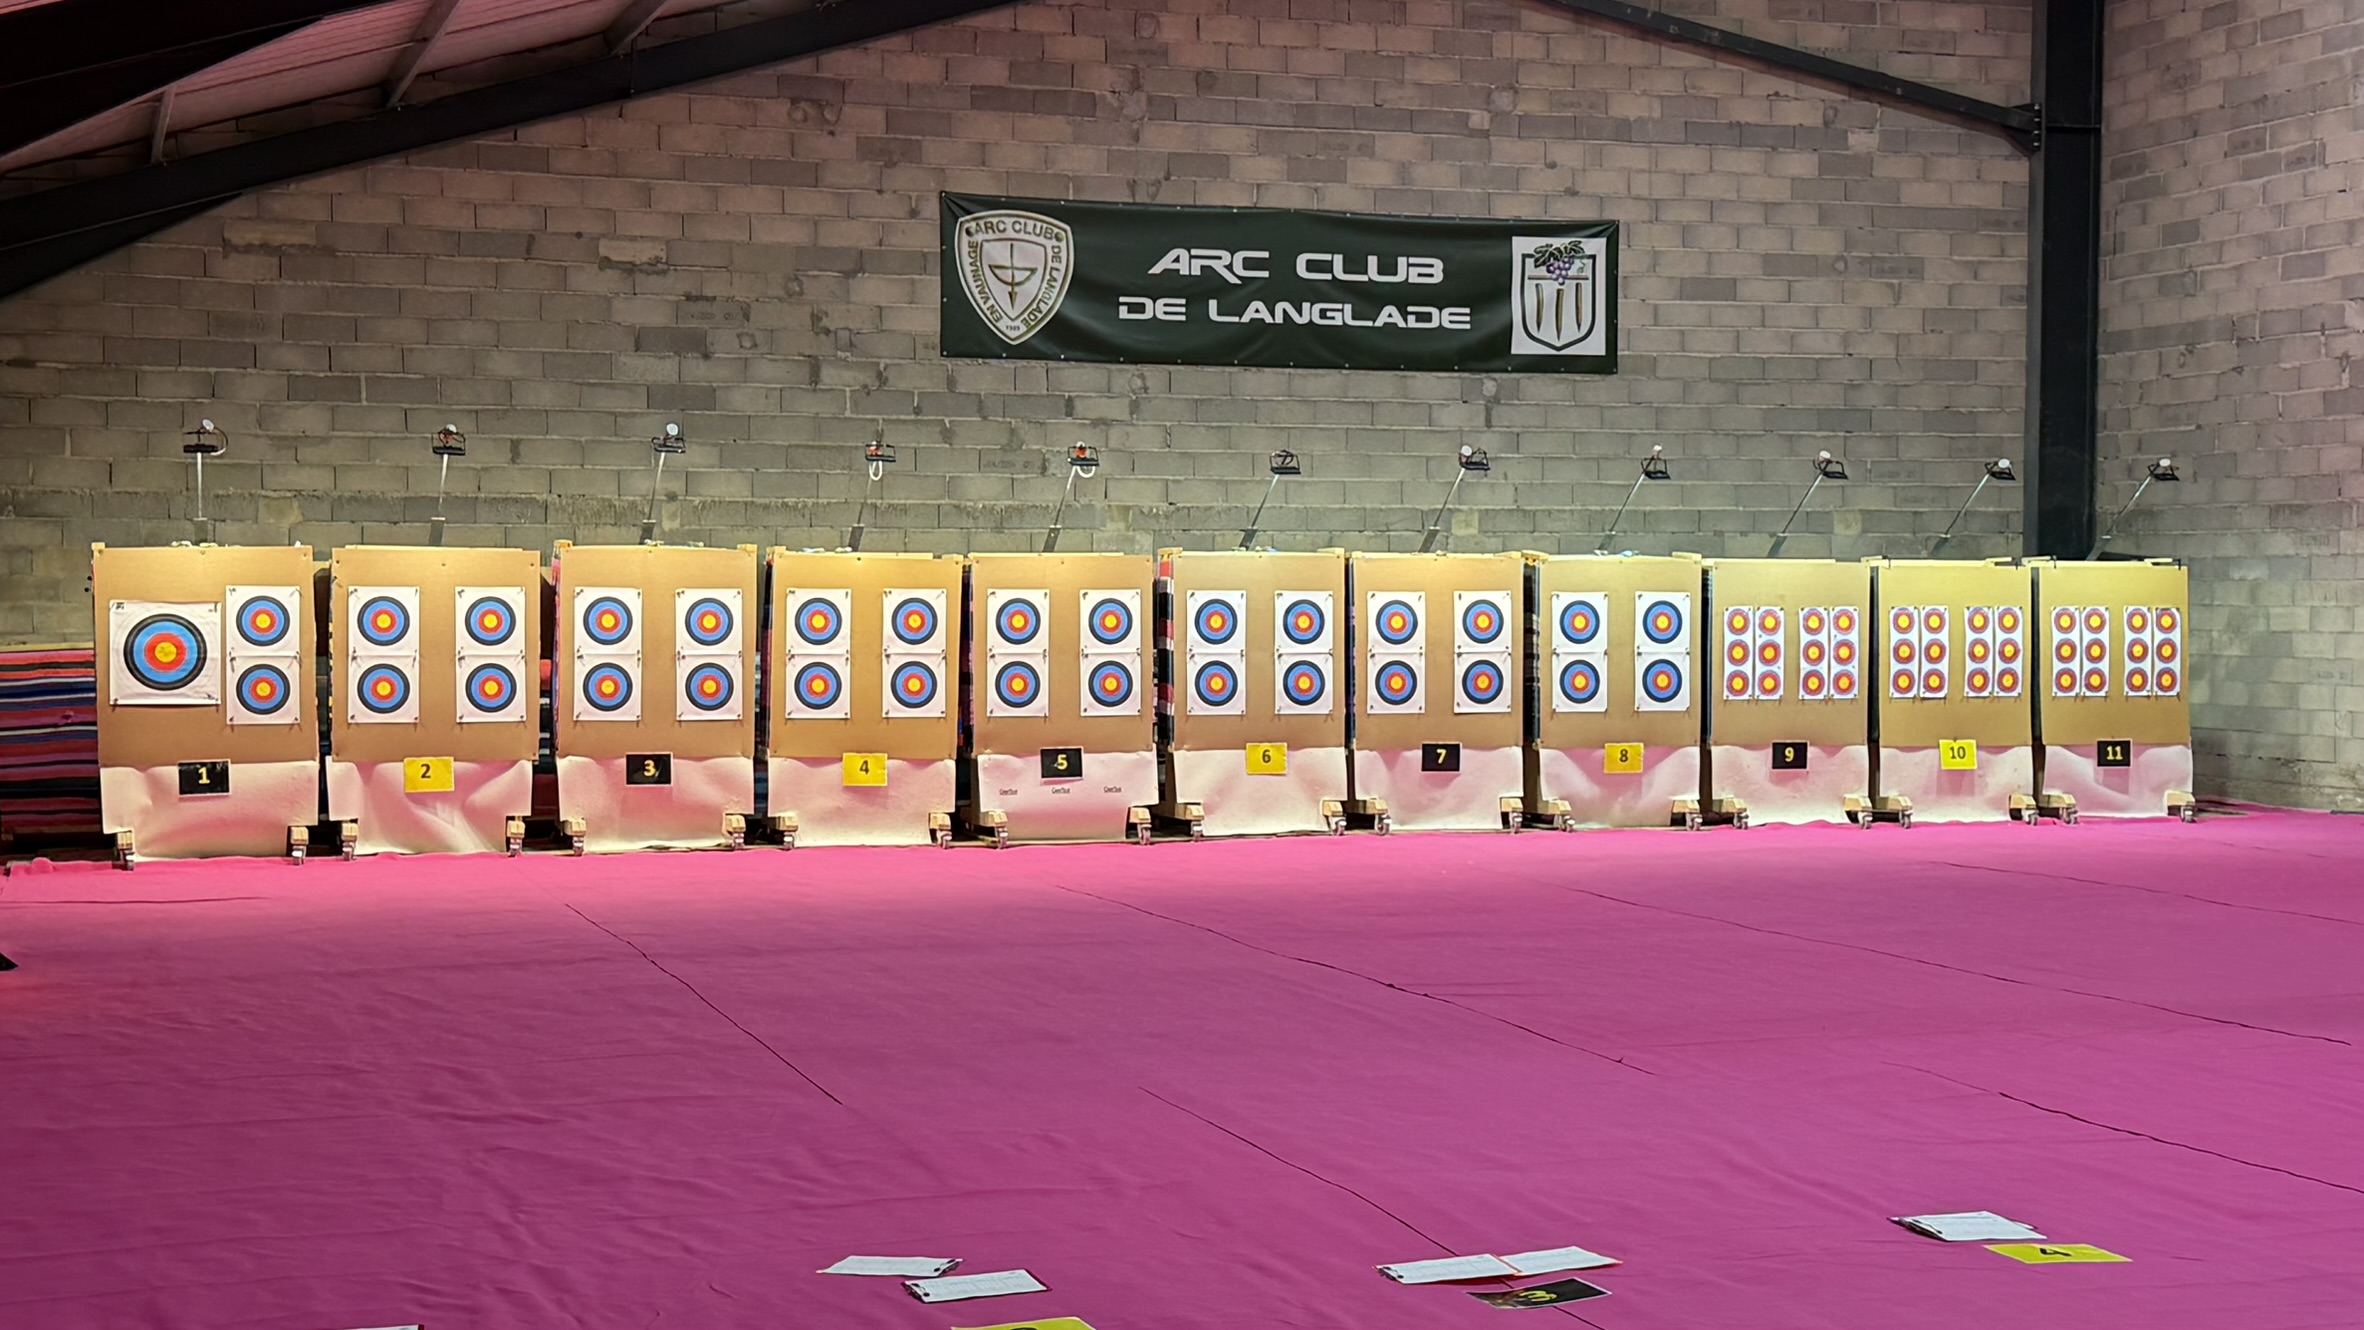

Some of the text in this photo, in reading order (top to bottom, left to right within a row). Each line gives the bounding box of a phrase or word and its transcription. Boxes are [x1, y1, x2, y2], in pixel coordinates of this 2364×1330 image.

[975, 220, 1054, 241] ARC CLUB
[1147, 248, 1444, 284] ARC CLUB
[968, 240, 1003, 323] EN VAUNAGE
[1020, 245, 1062, 328] DE LANGLADE
[1119, 296, 1471, 329] DE LANGLADE
[1261, 749, 1272, 764] 6
[1436, 749, 1447, 764] 7
[1619, 749, 1629, 763] 8
[1784, 747, 1794, 762] 9
[1949, 746, 1966, 760] 10
[2106, 745, 2123, 760] 11
[643, 760, 656, 777] 3
[859, 760, 870, 775] 4
[1057, 754, 1068, 770] 5
[198, 767, 210, 784] 1
[420, 764, 432, 779] 2
